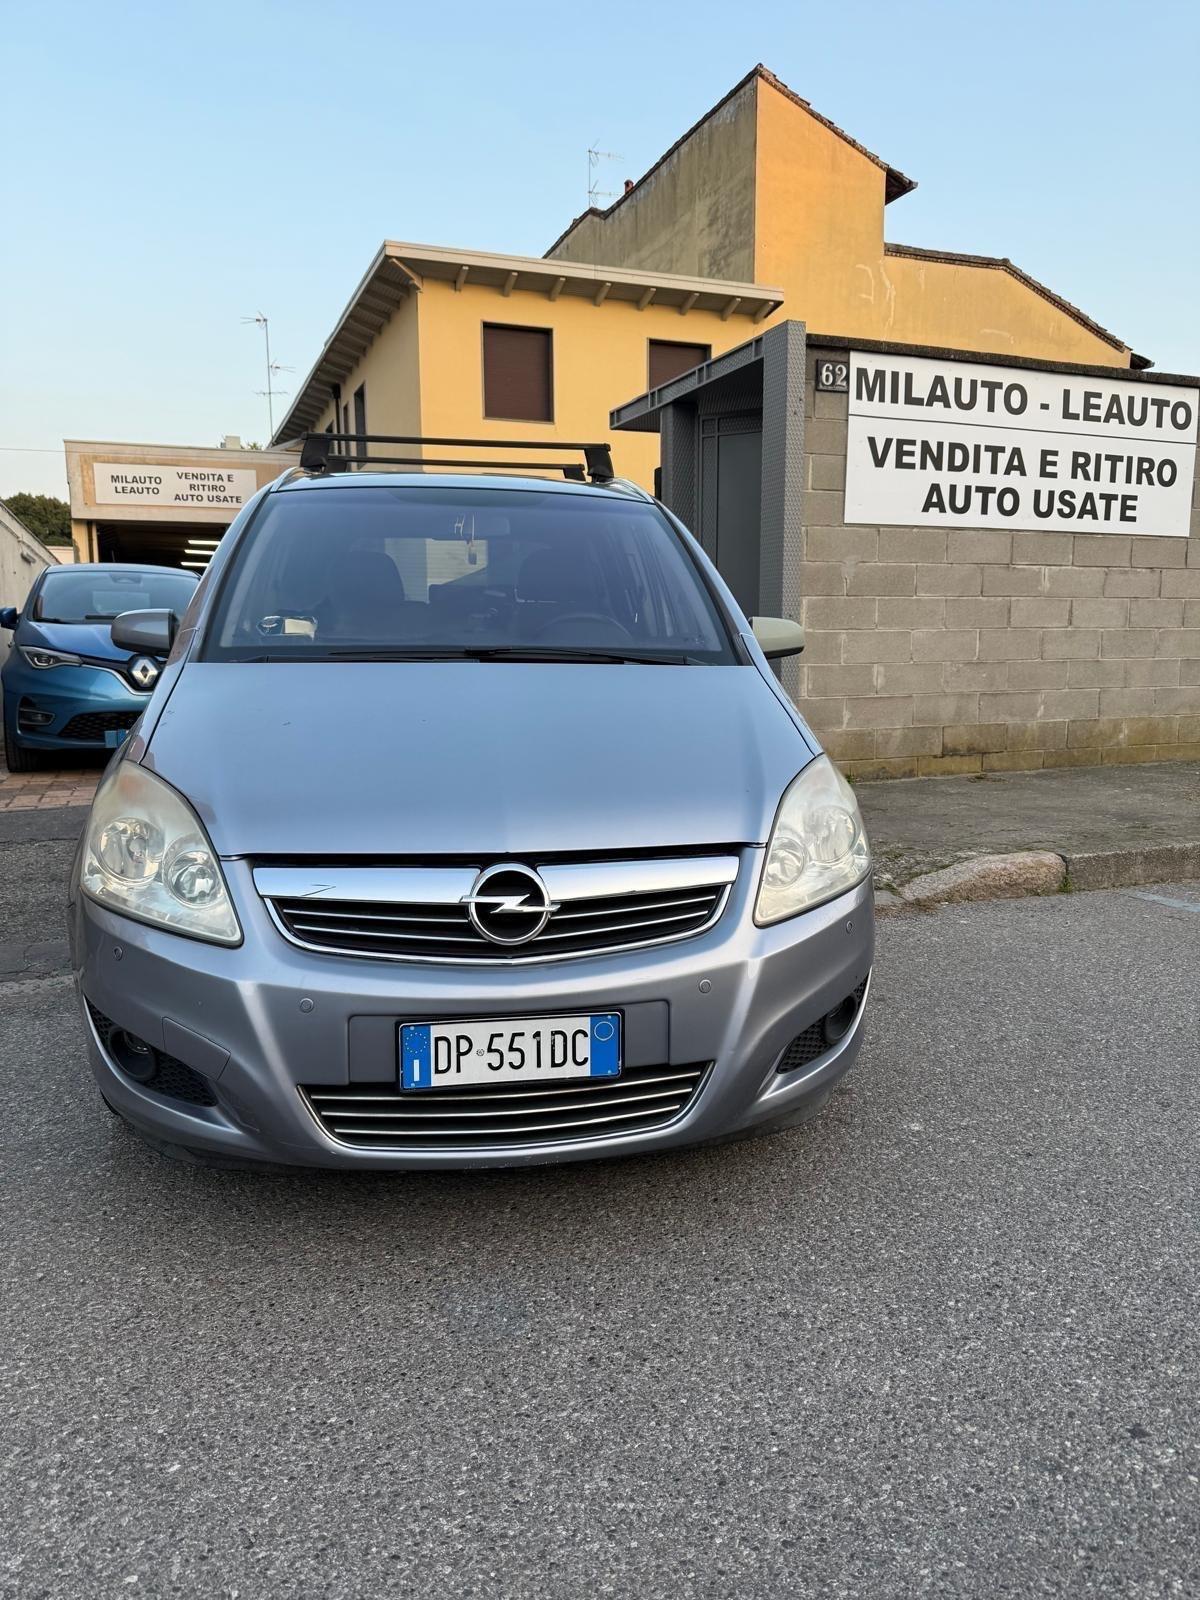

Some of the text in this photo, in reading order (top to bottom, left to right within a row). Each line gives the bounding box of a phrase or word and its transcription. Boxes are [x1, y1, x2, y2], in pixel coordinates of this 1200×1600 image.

[822, 363, 847, 387] 62
[855, 367, 1028, 415] MILAUTO
[1061, 388, 1193, 431] LEAUTO
[867, 435, 1178, 488] VENDITA E RITIRO
[111, 475, 162, 485] MILAUTO
[176, 471, 234, 483] VENDITA E
[114, 486, 160, 496] LEAUTO
[189, 483, 226, 493] RITIRO
[174, 493, 242, 504] AUTO USATE
[921, 483, 1139, 523] AUTO USATE
